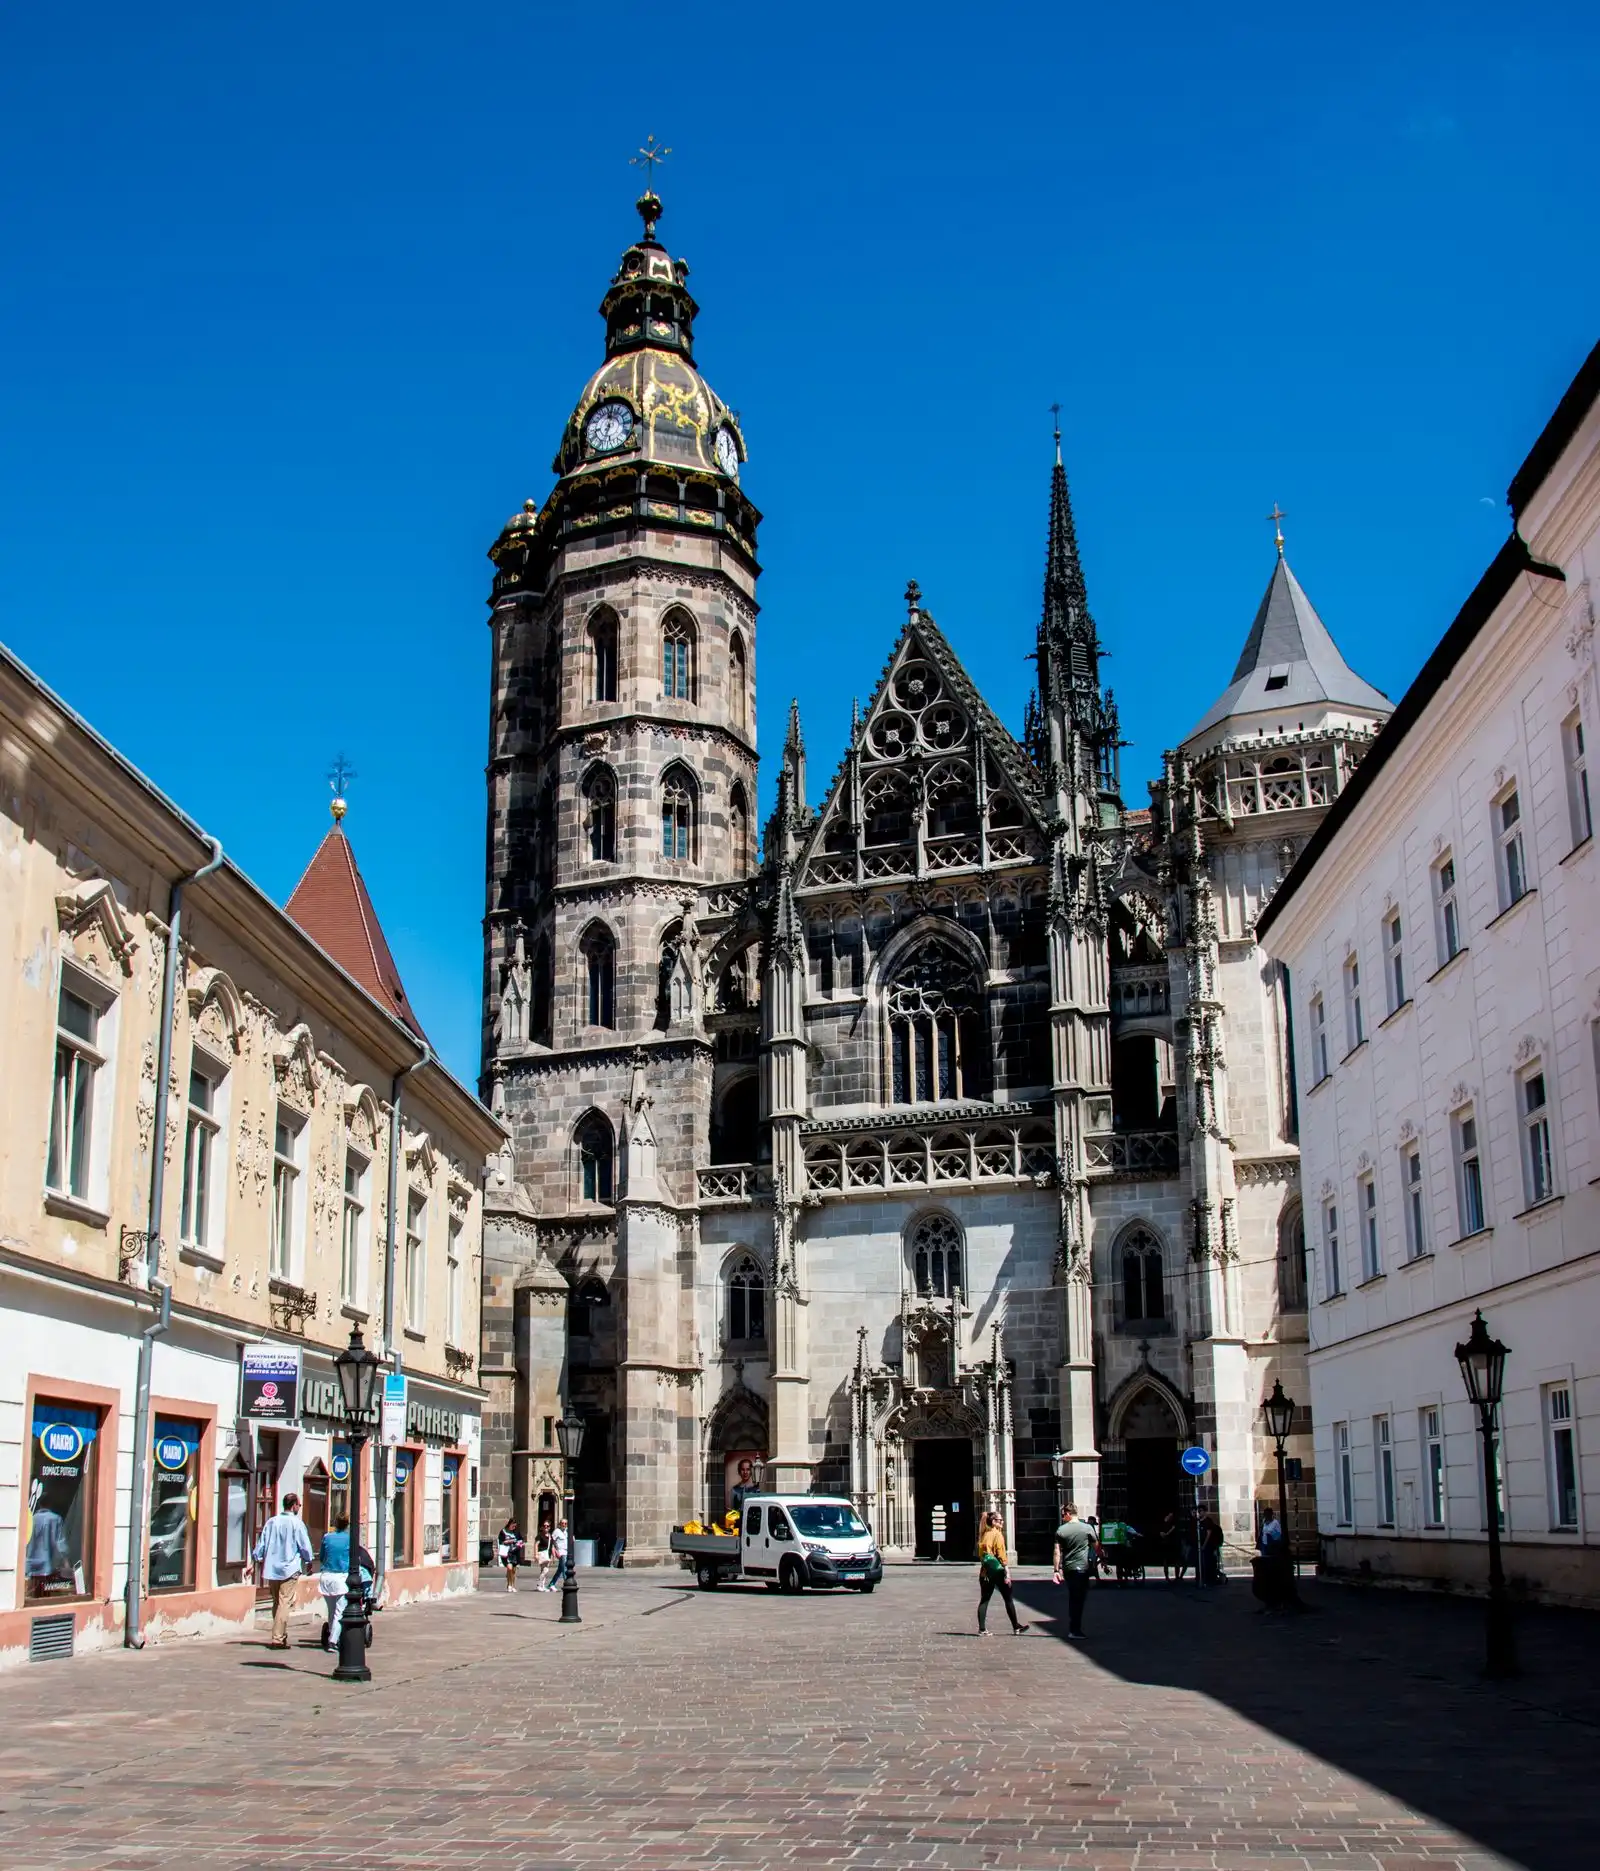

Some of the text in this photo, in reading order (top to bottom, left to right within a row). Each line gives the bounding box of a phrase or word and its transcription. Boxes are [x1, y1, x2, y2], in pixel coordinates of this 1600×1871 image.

[407, 1401, 463, 1439] POTREBY
[49, 1433, 74, 1451] MAKRO
[163, 1445, 182, 1460] MAKRO
